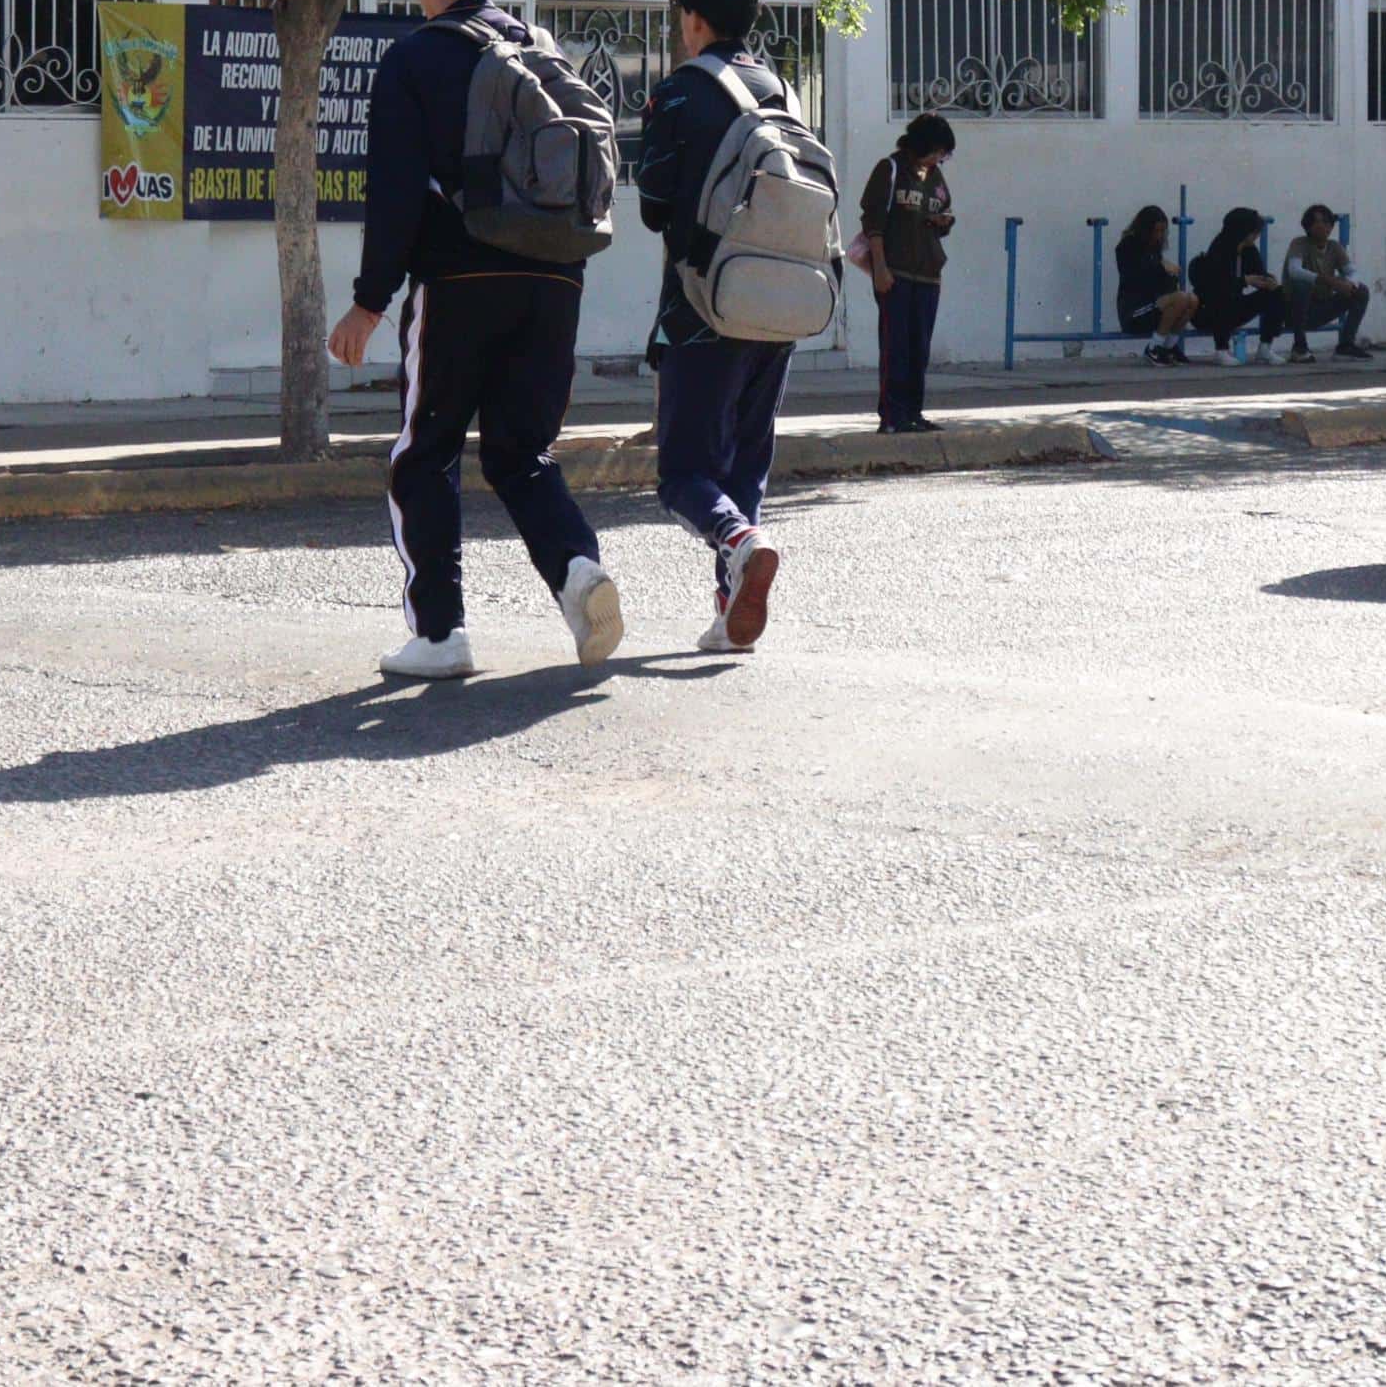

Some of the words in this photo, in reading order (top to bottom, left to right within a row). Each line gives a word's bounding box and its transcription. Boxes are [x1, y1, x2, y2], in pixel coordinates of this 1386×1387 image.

[203, 30, 220, 56] LA
[224, 31, 280, 59] AUDITO
[323, 36, 373, 63] PERIOR
[221, 63, 282, 90] RECONO
[344, 67, 362, 92] LA
[261, 96, 271, 121] Y
[351, 99, 371, 124] DE
[193, 126, 212, 151] DE
[215, 126, 233, 151] LA
[332, 125, 368, 155] AUTÓ
[136, 174, 172, 199] UAS
[189, 168, 242, 204] ¡BASTA
[246, 168, 265, 200] DE
